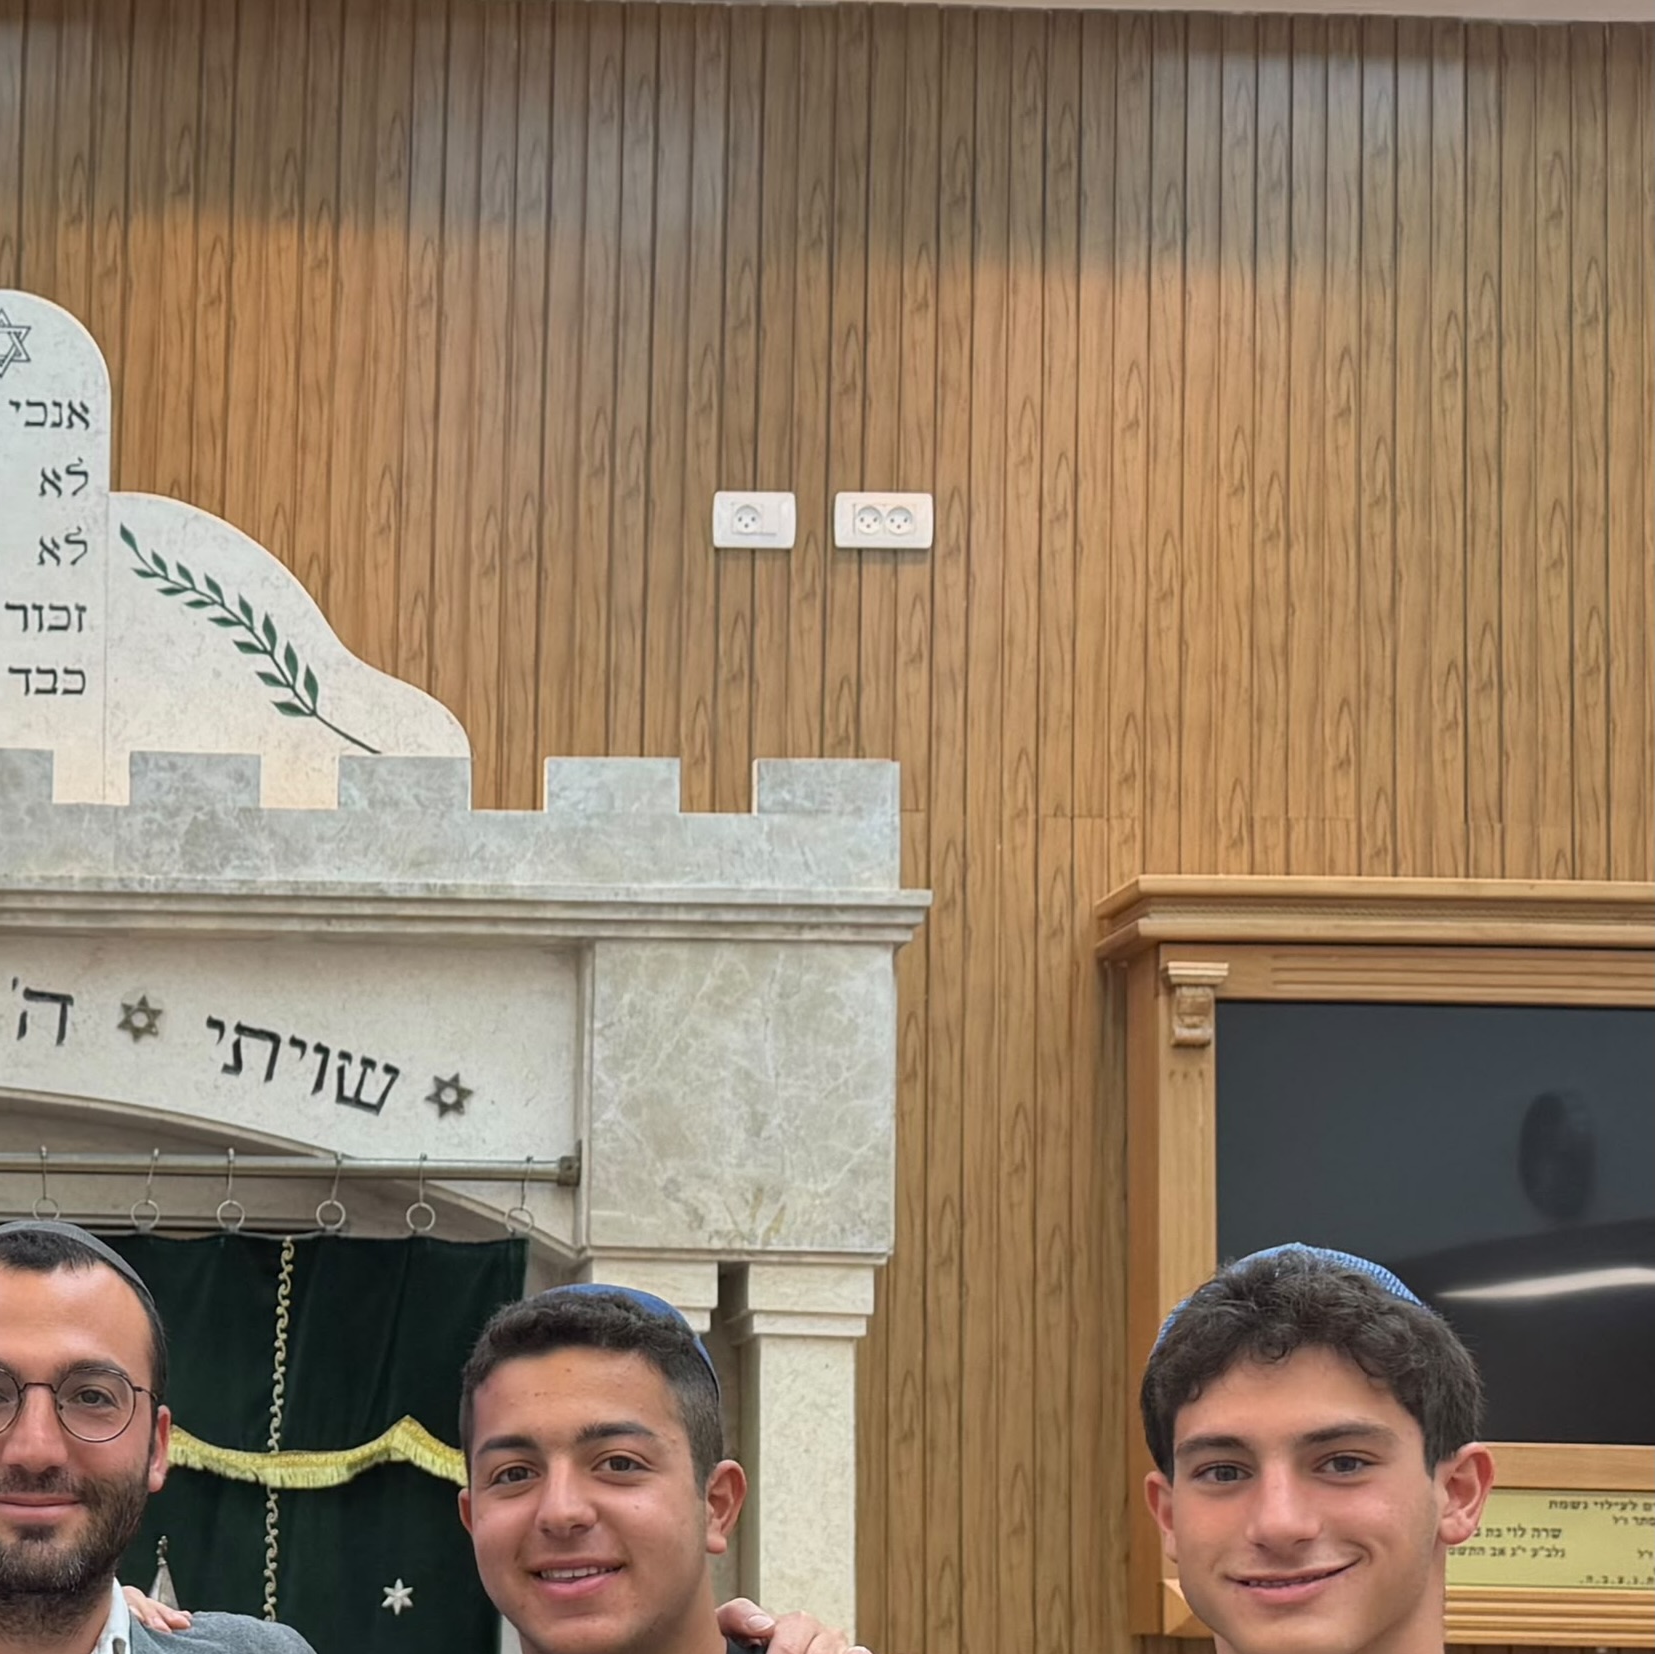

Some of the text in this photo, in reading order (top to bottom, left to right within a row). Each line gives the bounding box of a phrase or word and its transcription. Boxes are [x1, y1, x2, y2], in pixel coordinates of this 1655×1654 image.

[8, 399, 91, 431] אנכי
[38, 456, 90, 499] לא
[37, 525, 89, 567] לא
[3, 601, 88, 634] זכור
[7, 665, 87, 697] כבד
[11, 976, 75, 1047] ה'
[206, 1015, 401, 1118] שויתי
